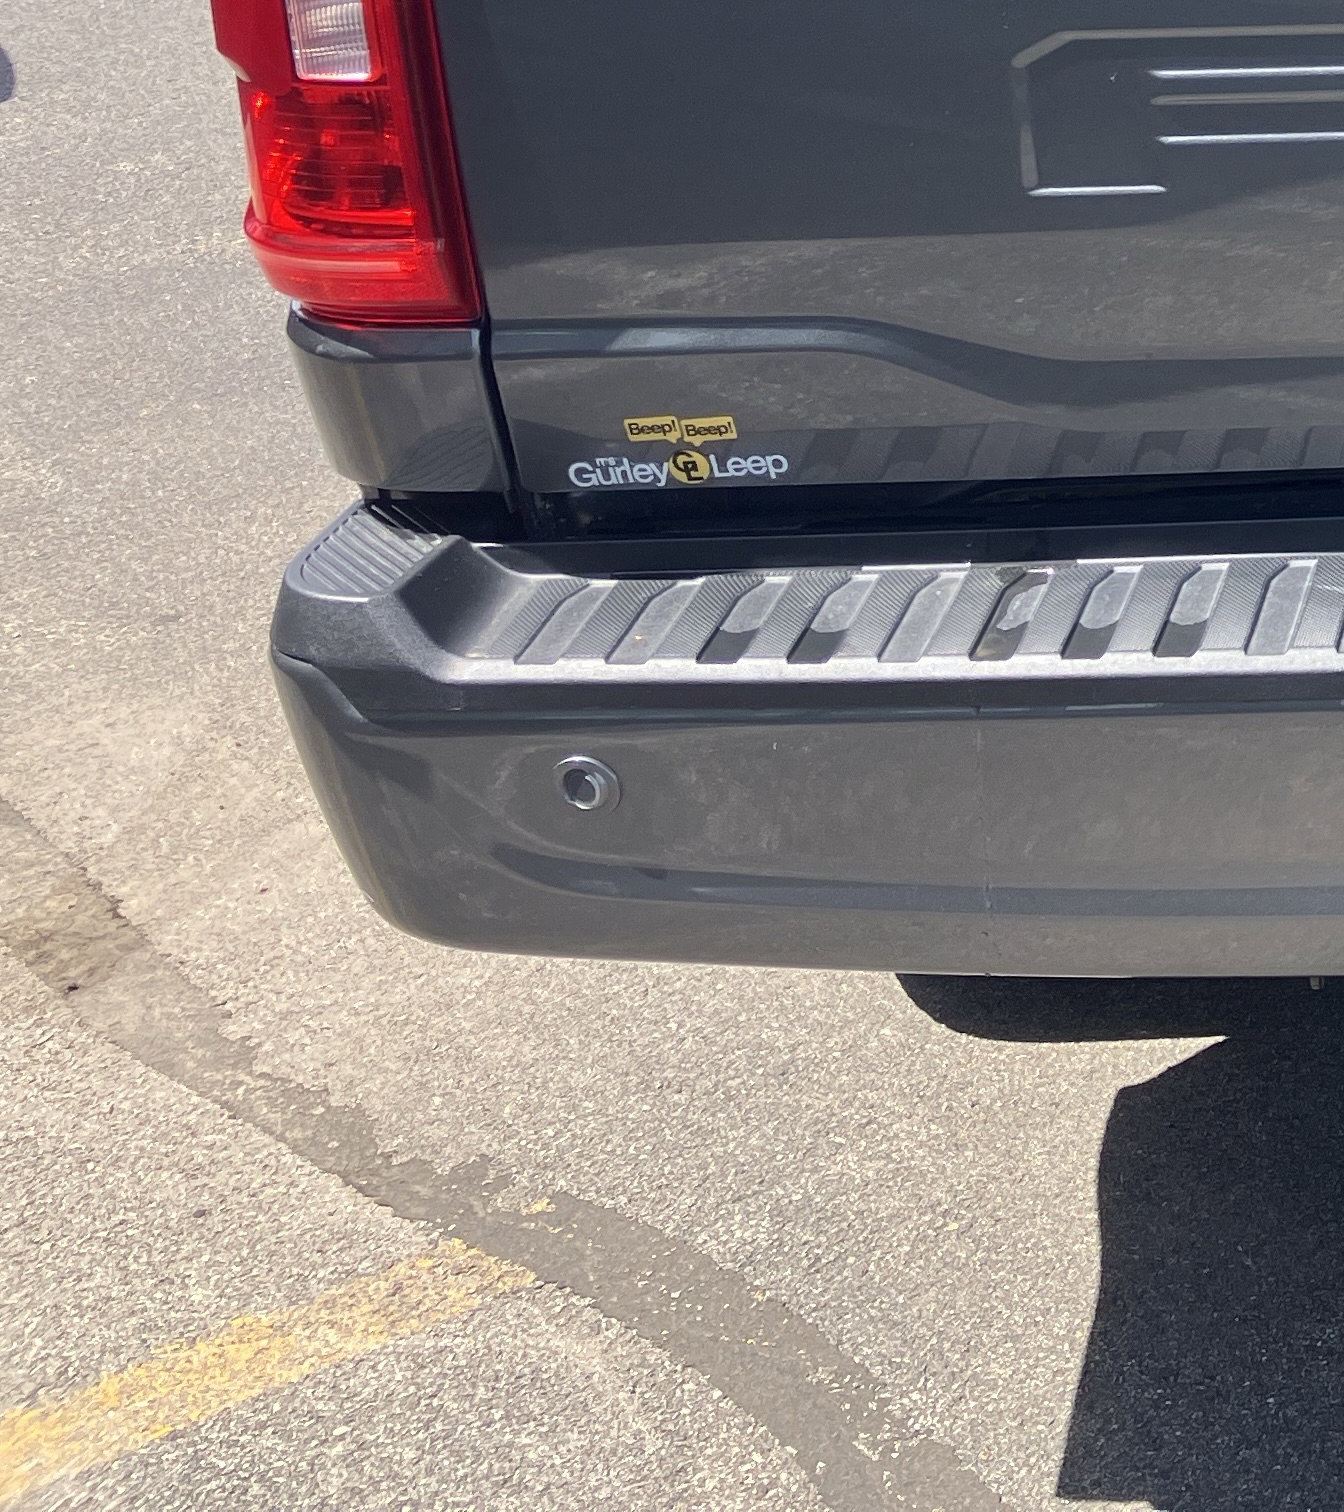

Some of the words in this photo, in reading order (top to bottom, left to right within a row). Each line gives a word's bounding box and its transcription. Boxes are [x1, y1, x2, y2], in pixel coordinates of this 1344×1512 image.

[627, 419, 677, 436] Beep!
[684, 420, 734, 437] Beep!
[708, 453, 789, 480] Leep
